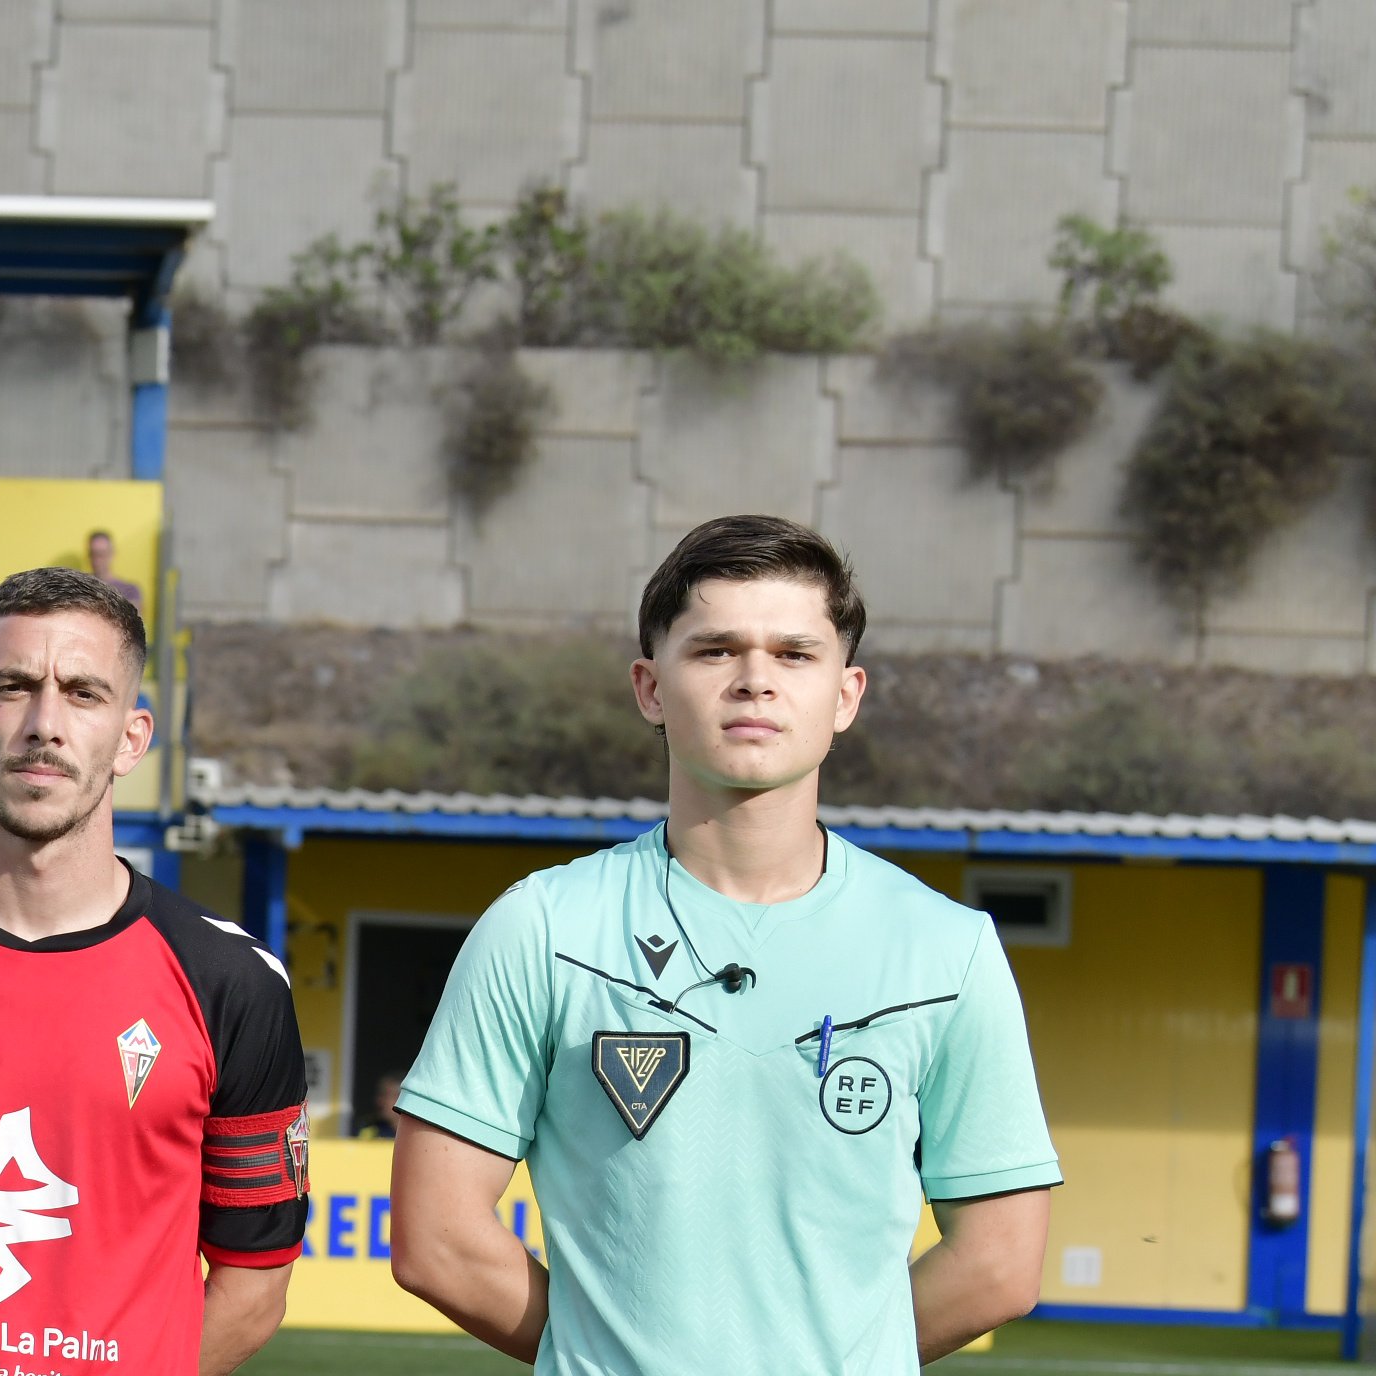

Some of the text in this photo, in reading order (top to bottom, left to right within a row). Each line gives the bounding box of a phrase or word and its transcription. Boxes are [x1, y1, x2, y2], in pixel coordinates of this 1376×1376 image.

[631, 1102, 648, 1111] CTA
[1, 1322, 35, 1355] La
[43, 1327, 120, 1362] Palma
